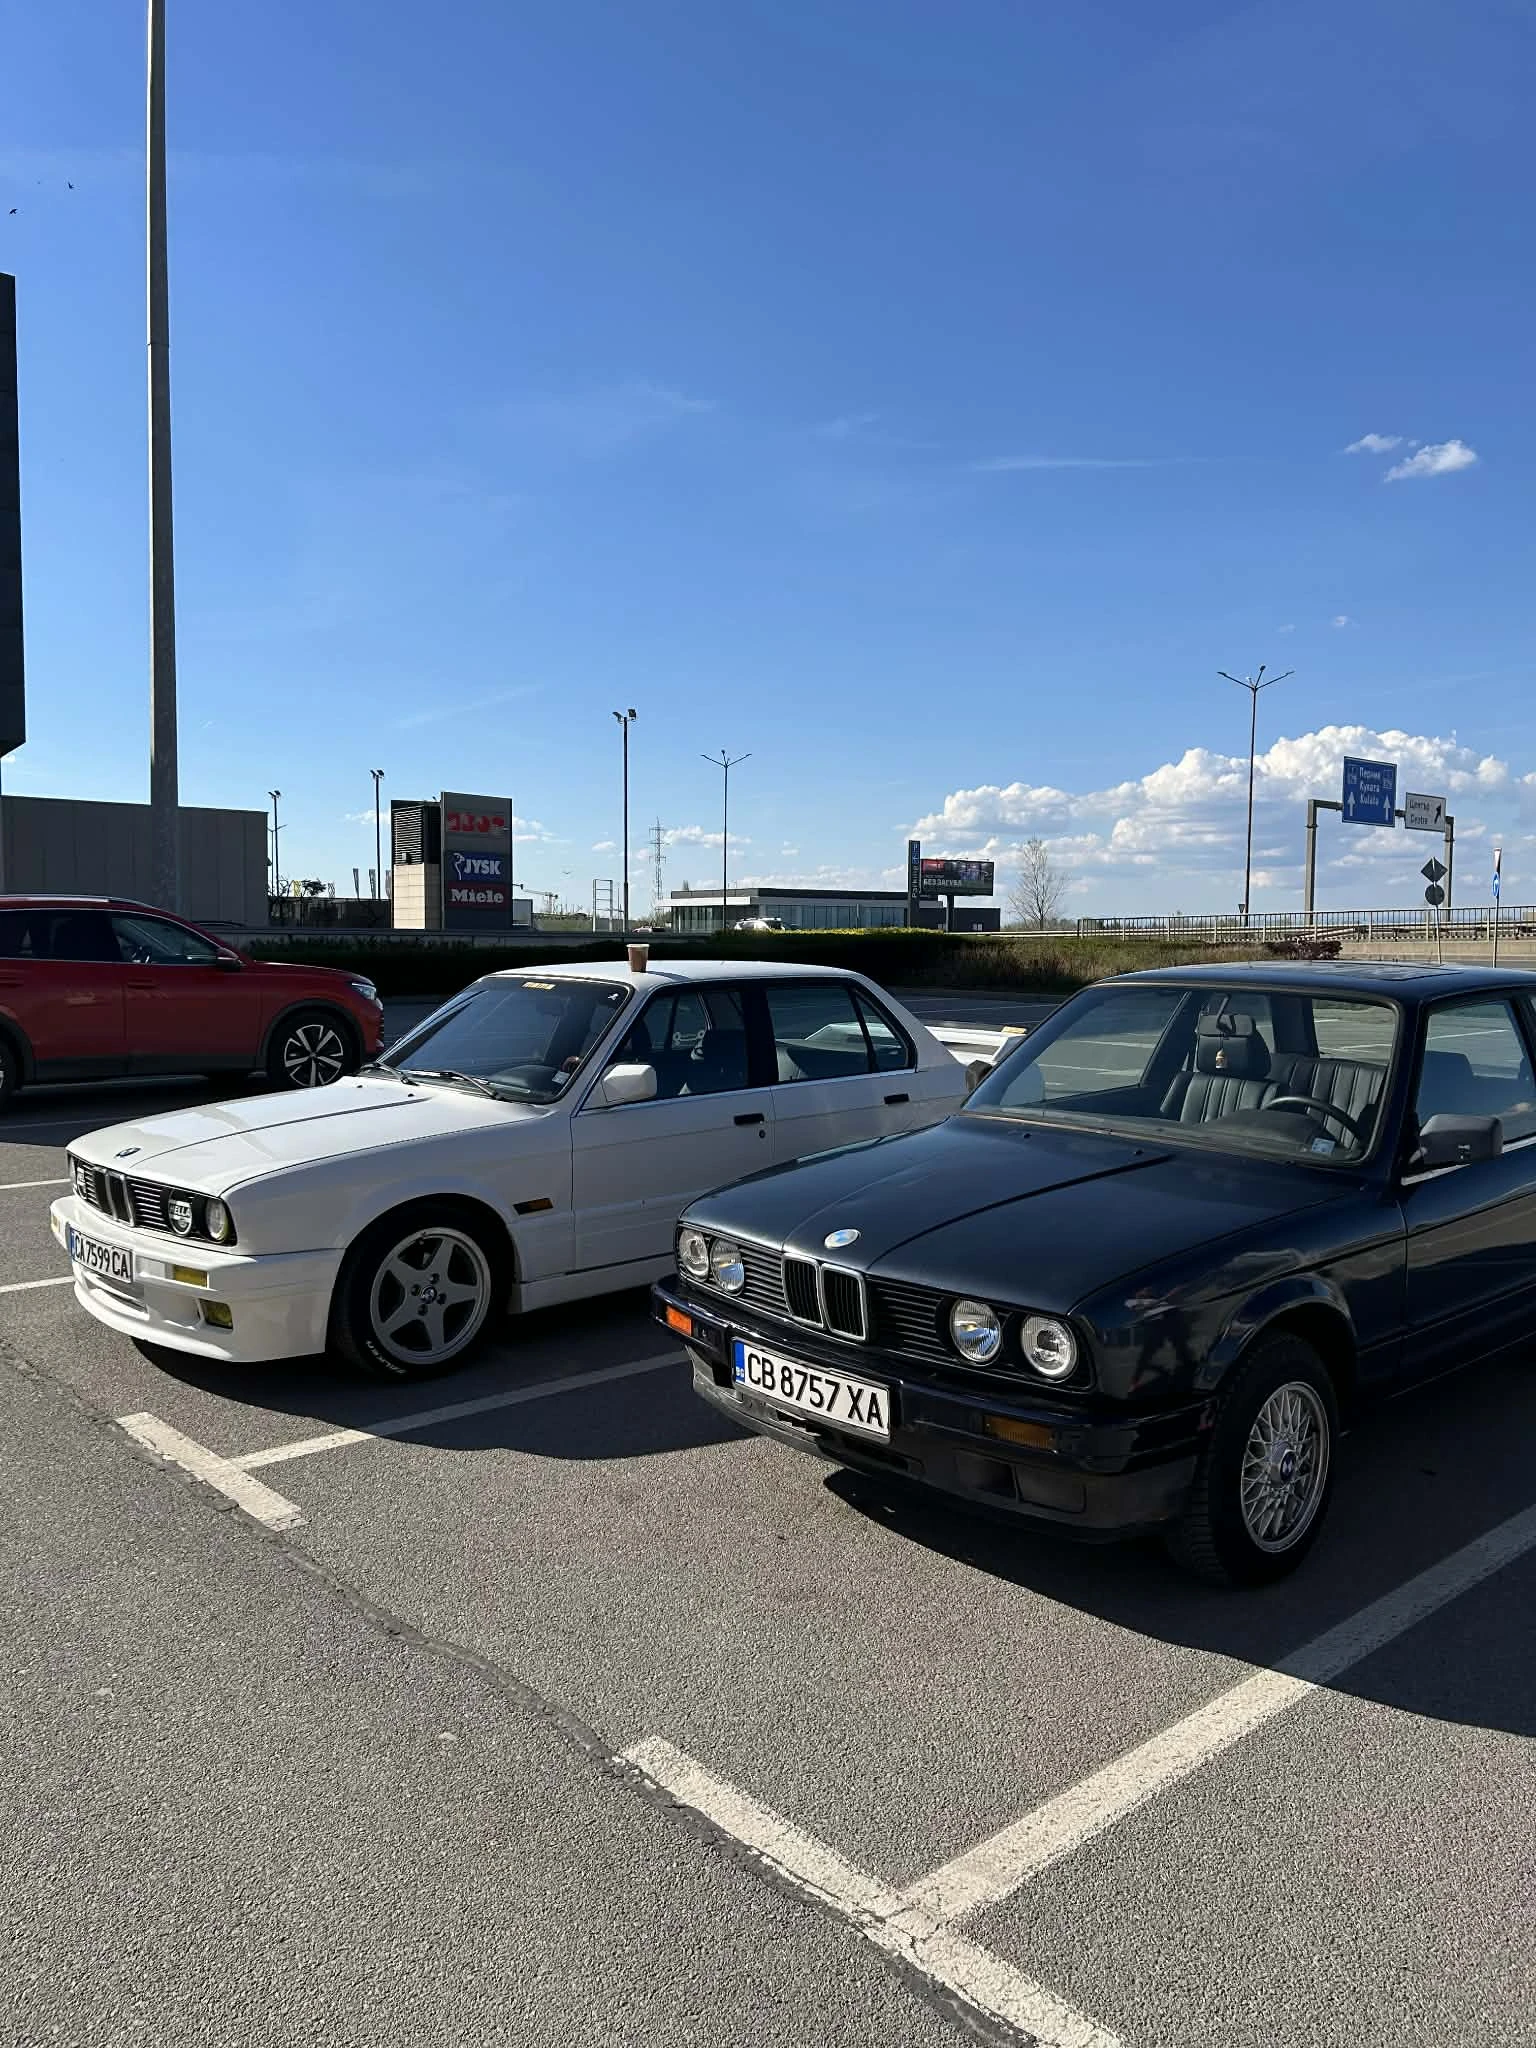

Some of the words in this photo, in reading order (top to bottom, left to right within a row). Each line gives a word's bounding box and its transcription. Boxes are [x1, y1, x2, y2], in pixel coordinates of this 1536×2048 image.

[463, 859, 501, 875] JYSK
[451, 889, 504, 903] Miele
[169, 1203, 192, 1218] HELLA
[74, 1235, 85, 1263] CA
[86, 1241, 110, 1272] 7599
[112, 1250, 130, 1279] CA
[748, 1353, 776, 1391] CB
[780, 1365, 841, 1413] 8757
[846, 1384, 884, 1429] XA
